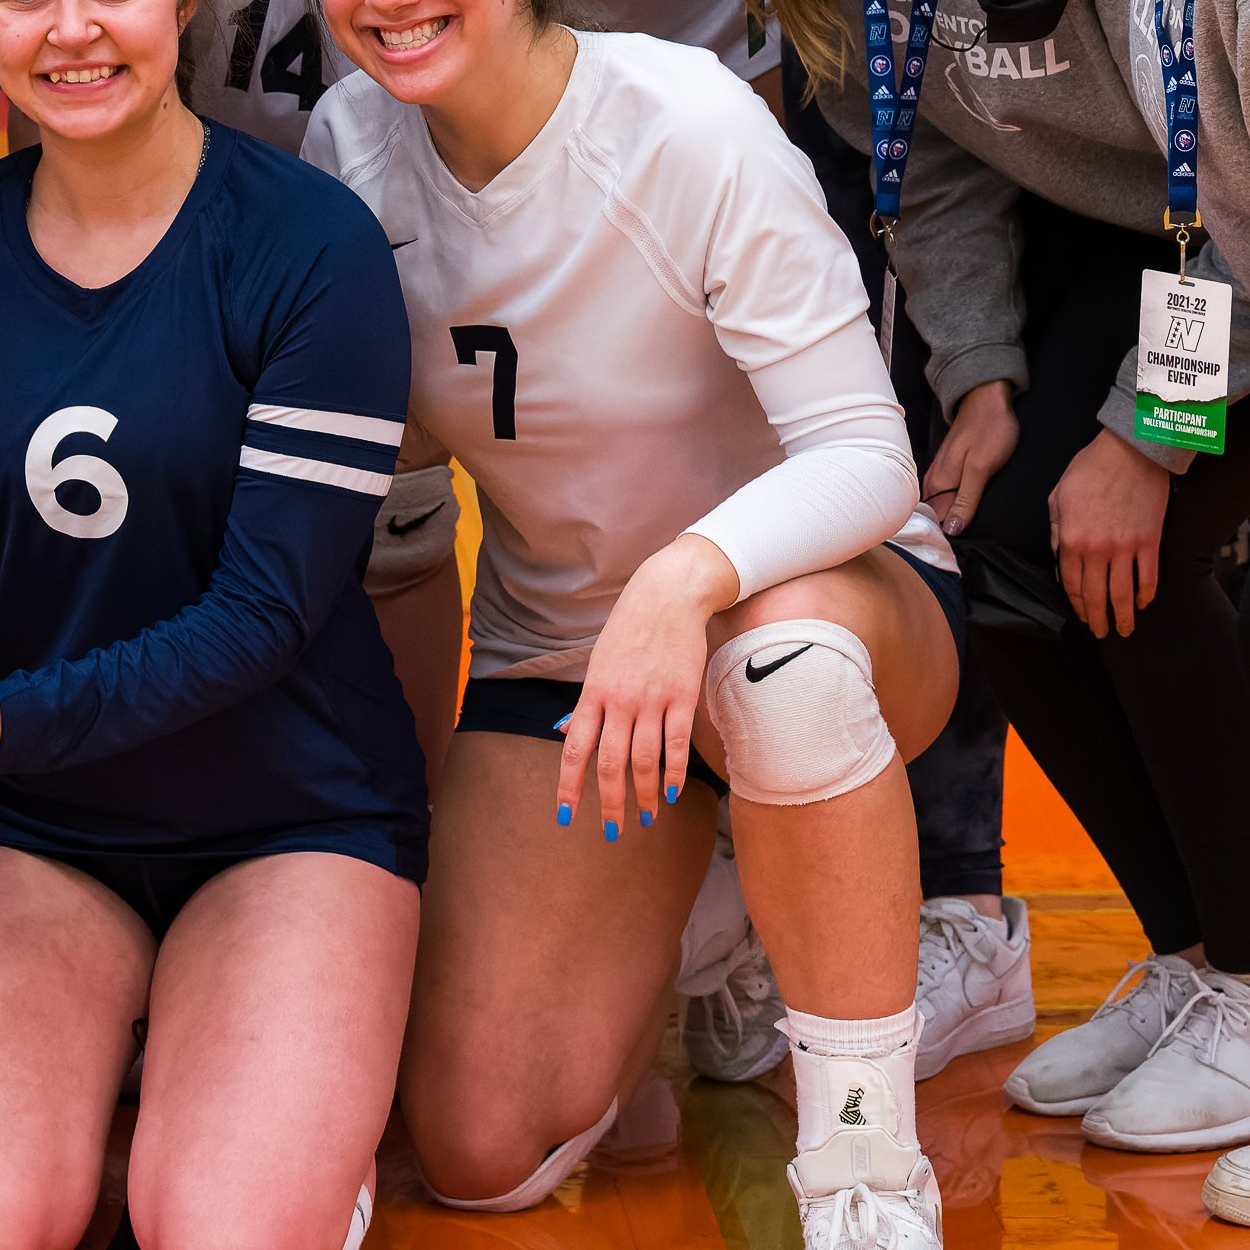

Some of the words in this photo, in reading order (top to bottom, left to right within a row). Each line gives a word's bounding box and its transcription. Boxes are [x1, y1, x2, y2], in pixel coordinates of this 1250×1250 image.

[1166, 292, 1207, 312] 2021-22
[1147, 350, 1221, 376] CHAMPIONSHIP
[448, 324, 519, 440] 7
[1167, 369, 1198, 387] EVENT
[1142, 416, 1175, 431] VOLLEYBALL
[1174, 423, 1218, 438] CHAMPIONSHIP
[1153, 406, 1207, 427] PARTICIPANT
[24, 405, 129, 539] 6
